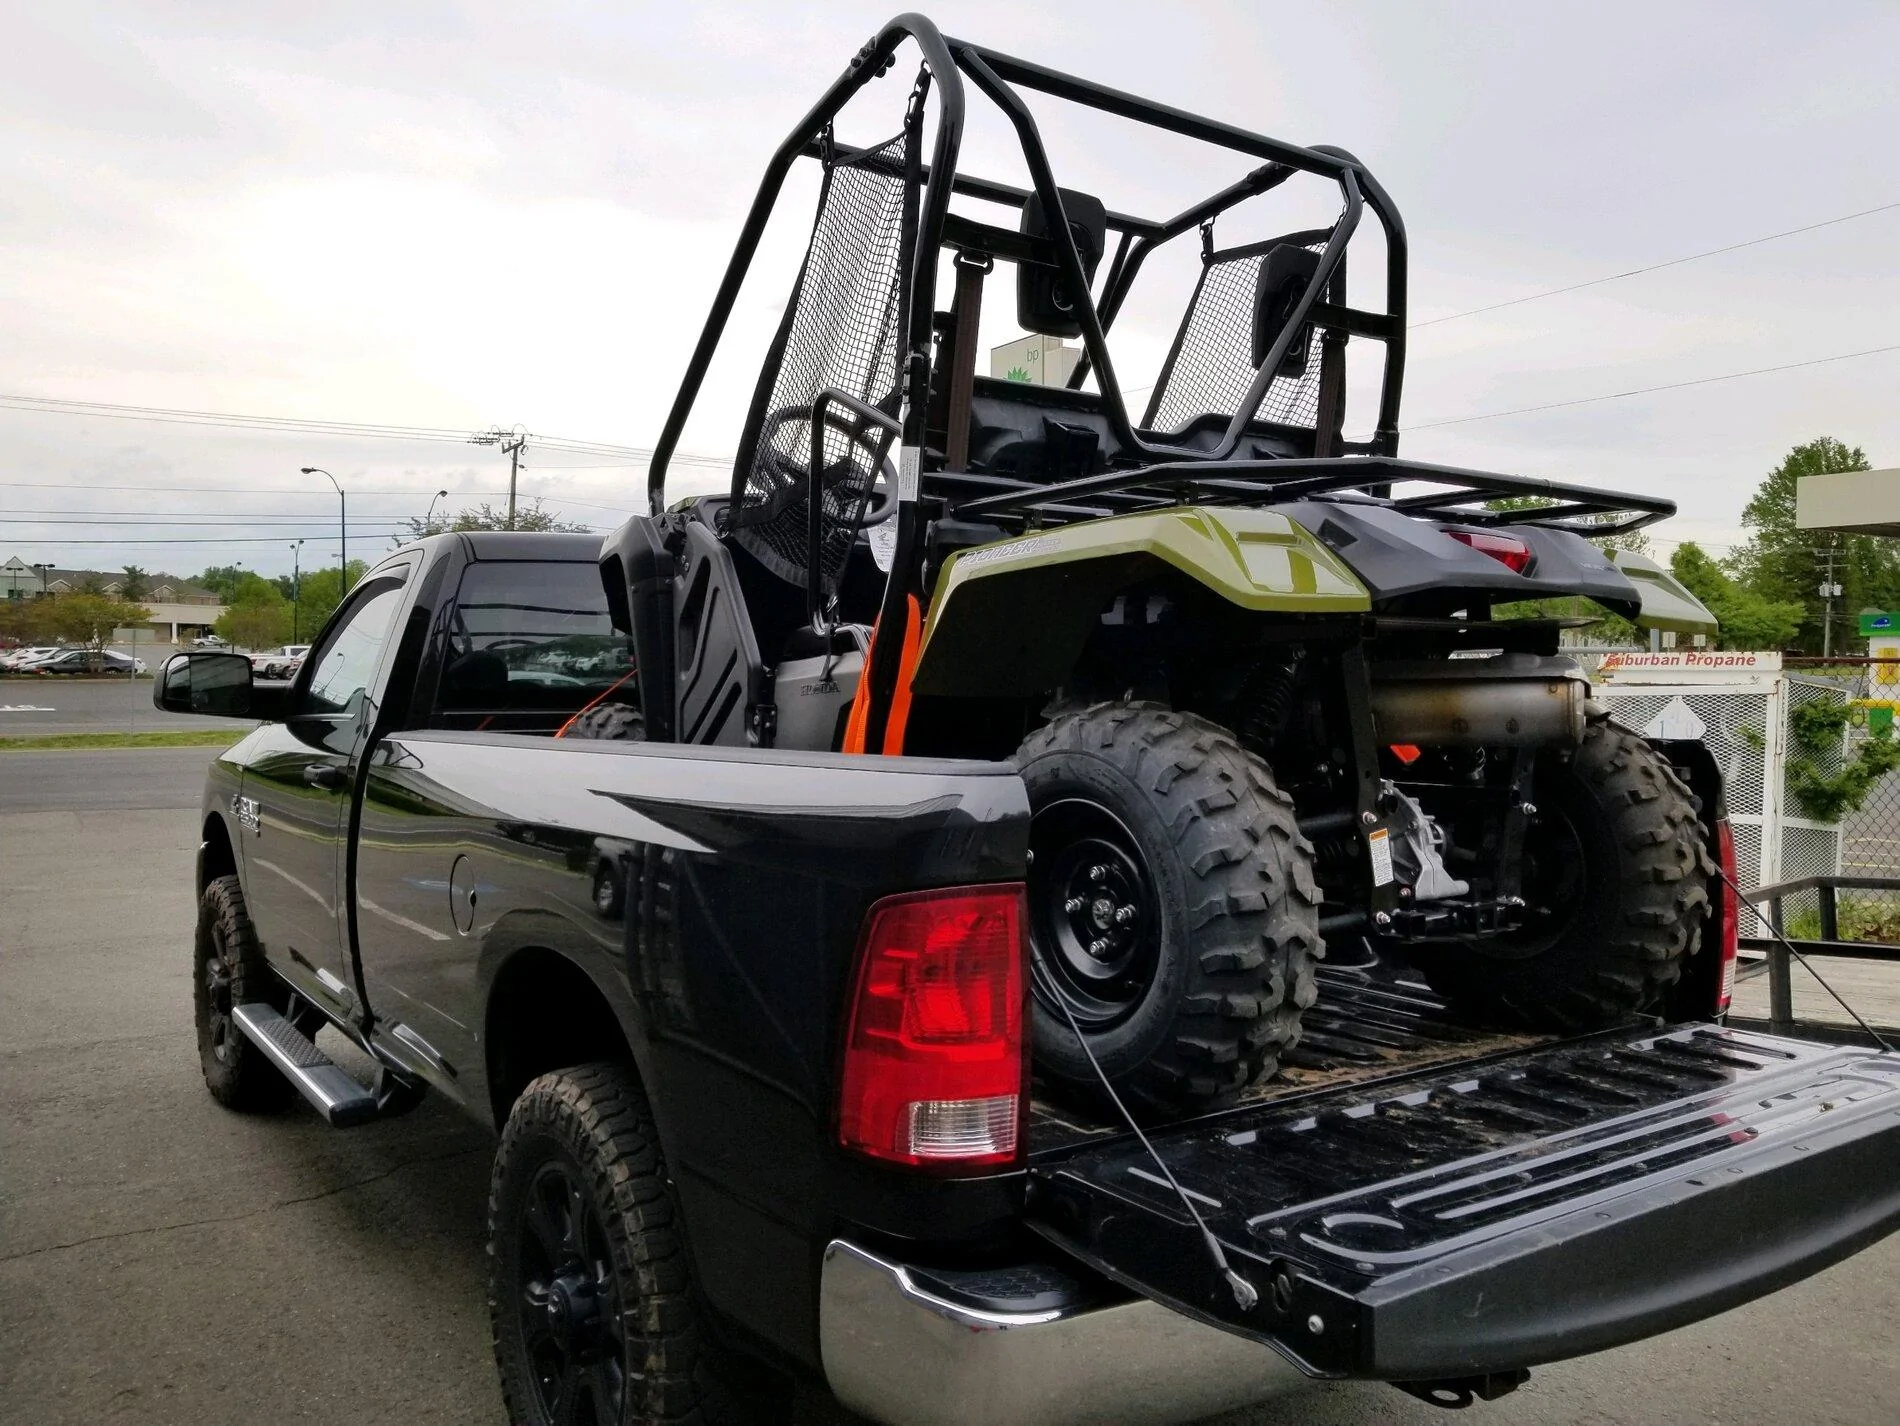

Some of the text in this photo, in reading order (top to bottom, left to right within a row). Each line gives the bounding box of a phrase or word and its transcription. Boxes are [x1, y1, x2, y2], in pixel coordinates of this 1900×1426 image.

[1026, 348, 1039, 364] bp
[1605, 652, 1757, 668] Suburban Propane
